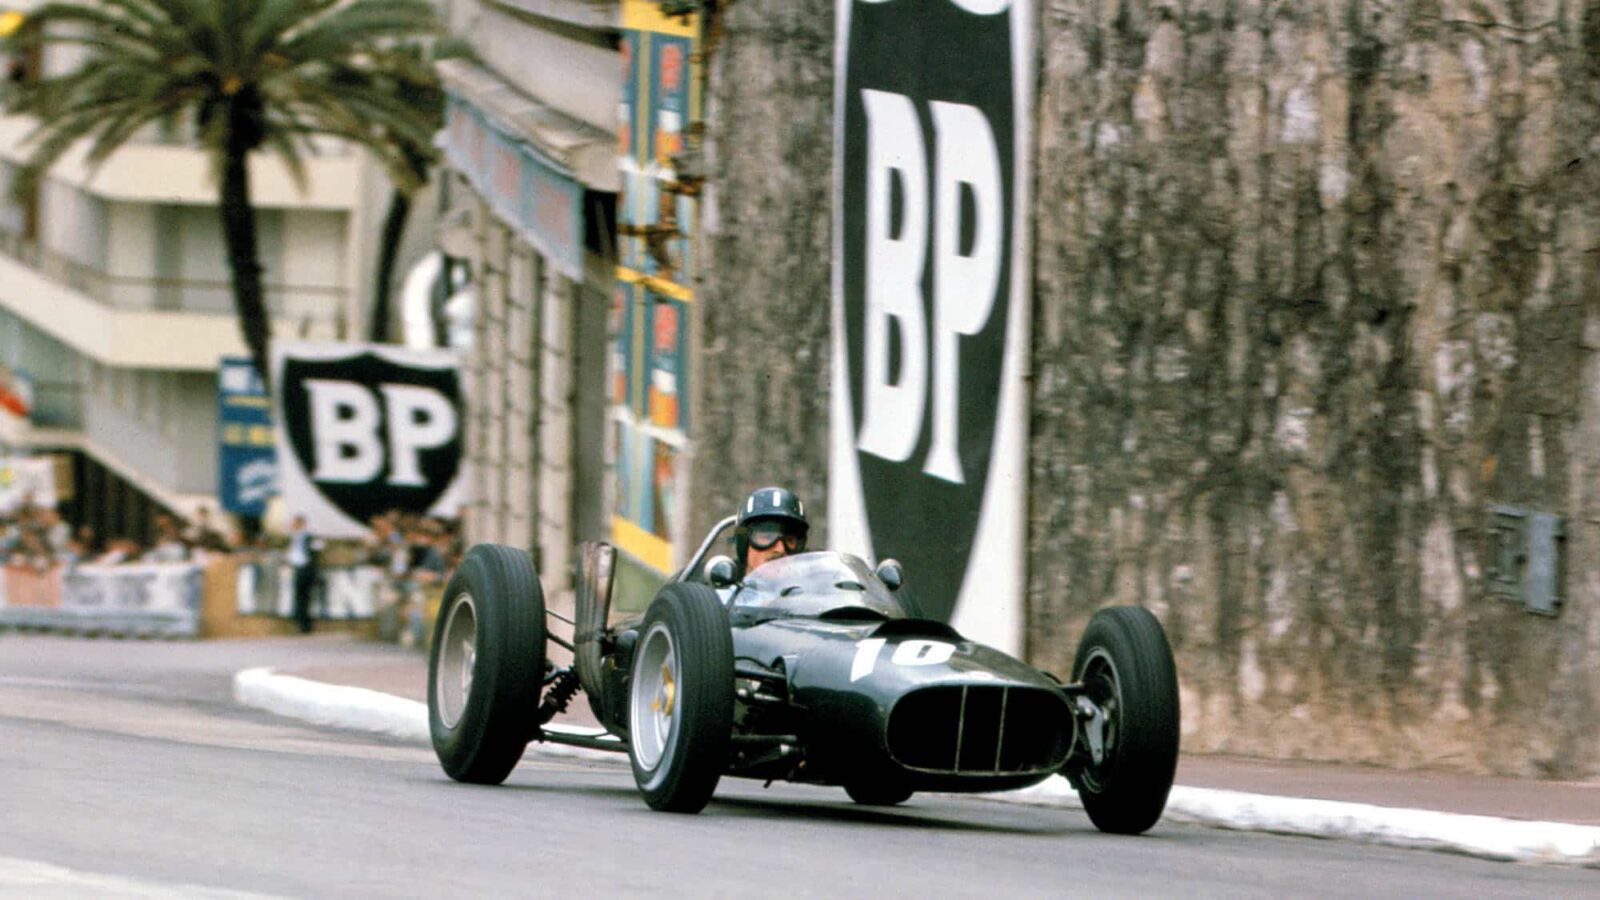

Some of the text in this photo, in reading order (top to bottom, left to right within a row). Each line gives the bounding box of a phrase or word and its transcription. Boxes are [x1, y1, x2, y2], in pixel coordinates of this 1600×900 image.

[859, 88, 1004, 484] BP
[303, 379, 457, 486] BP
[850, 638, 957, 683] 10
